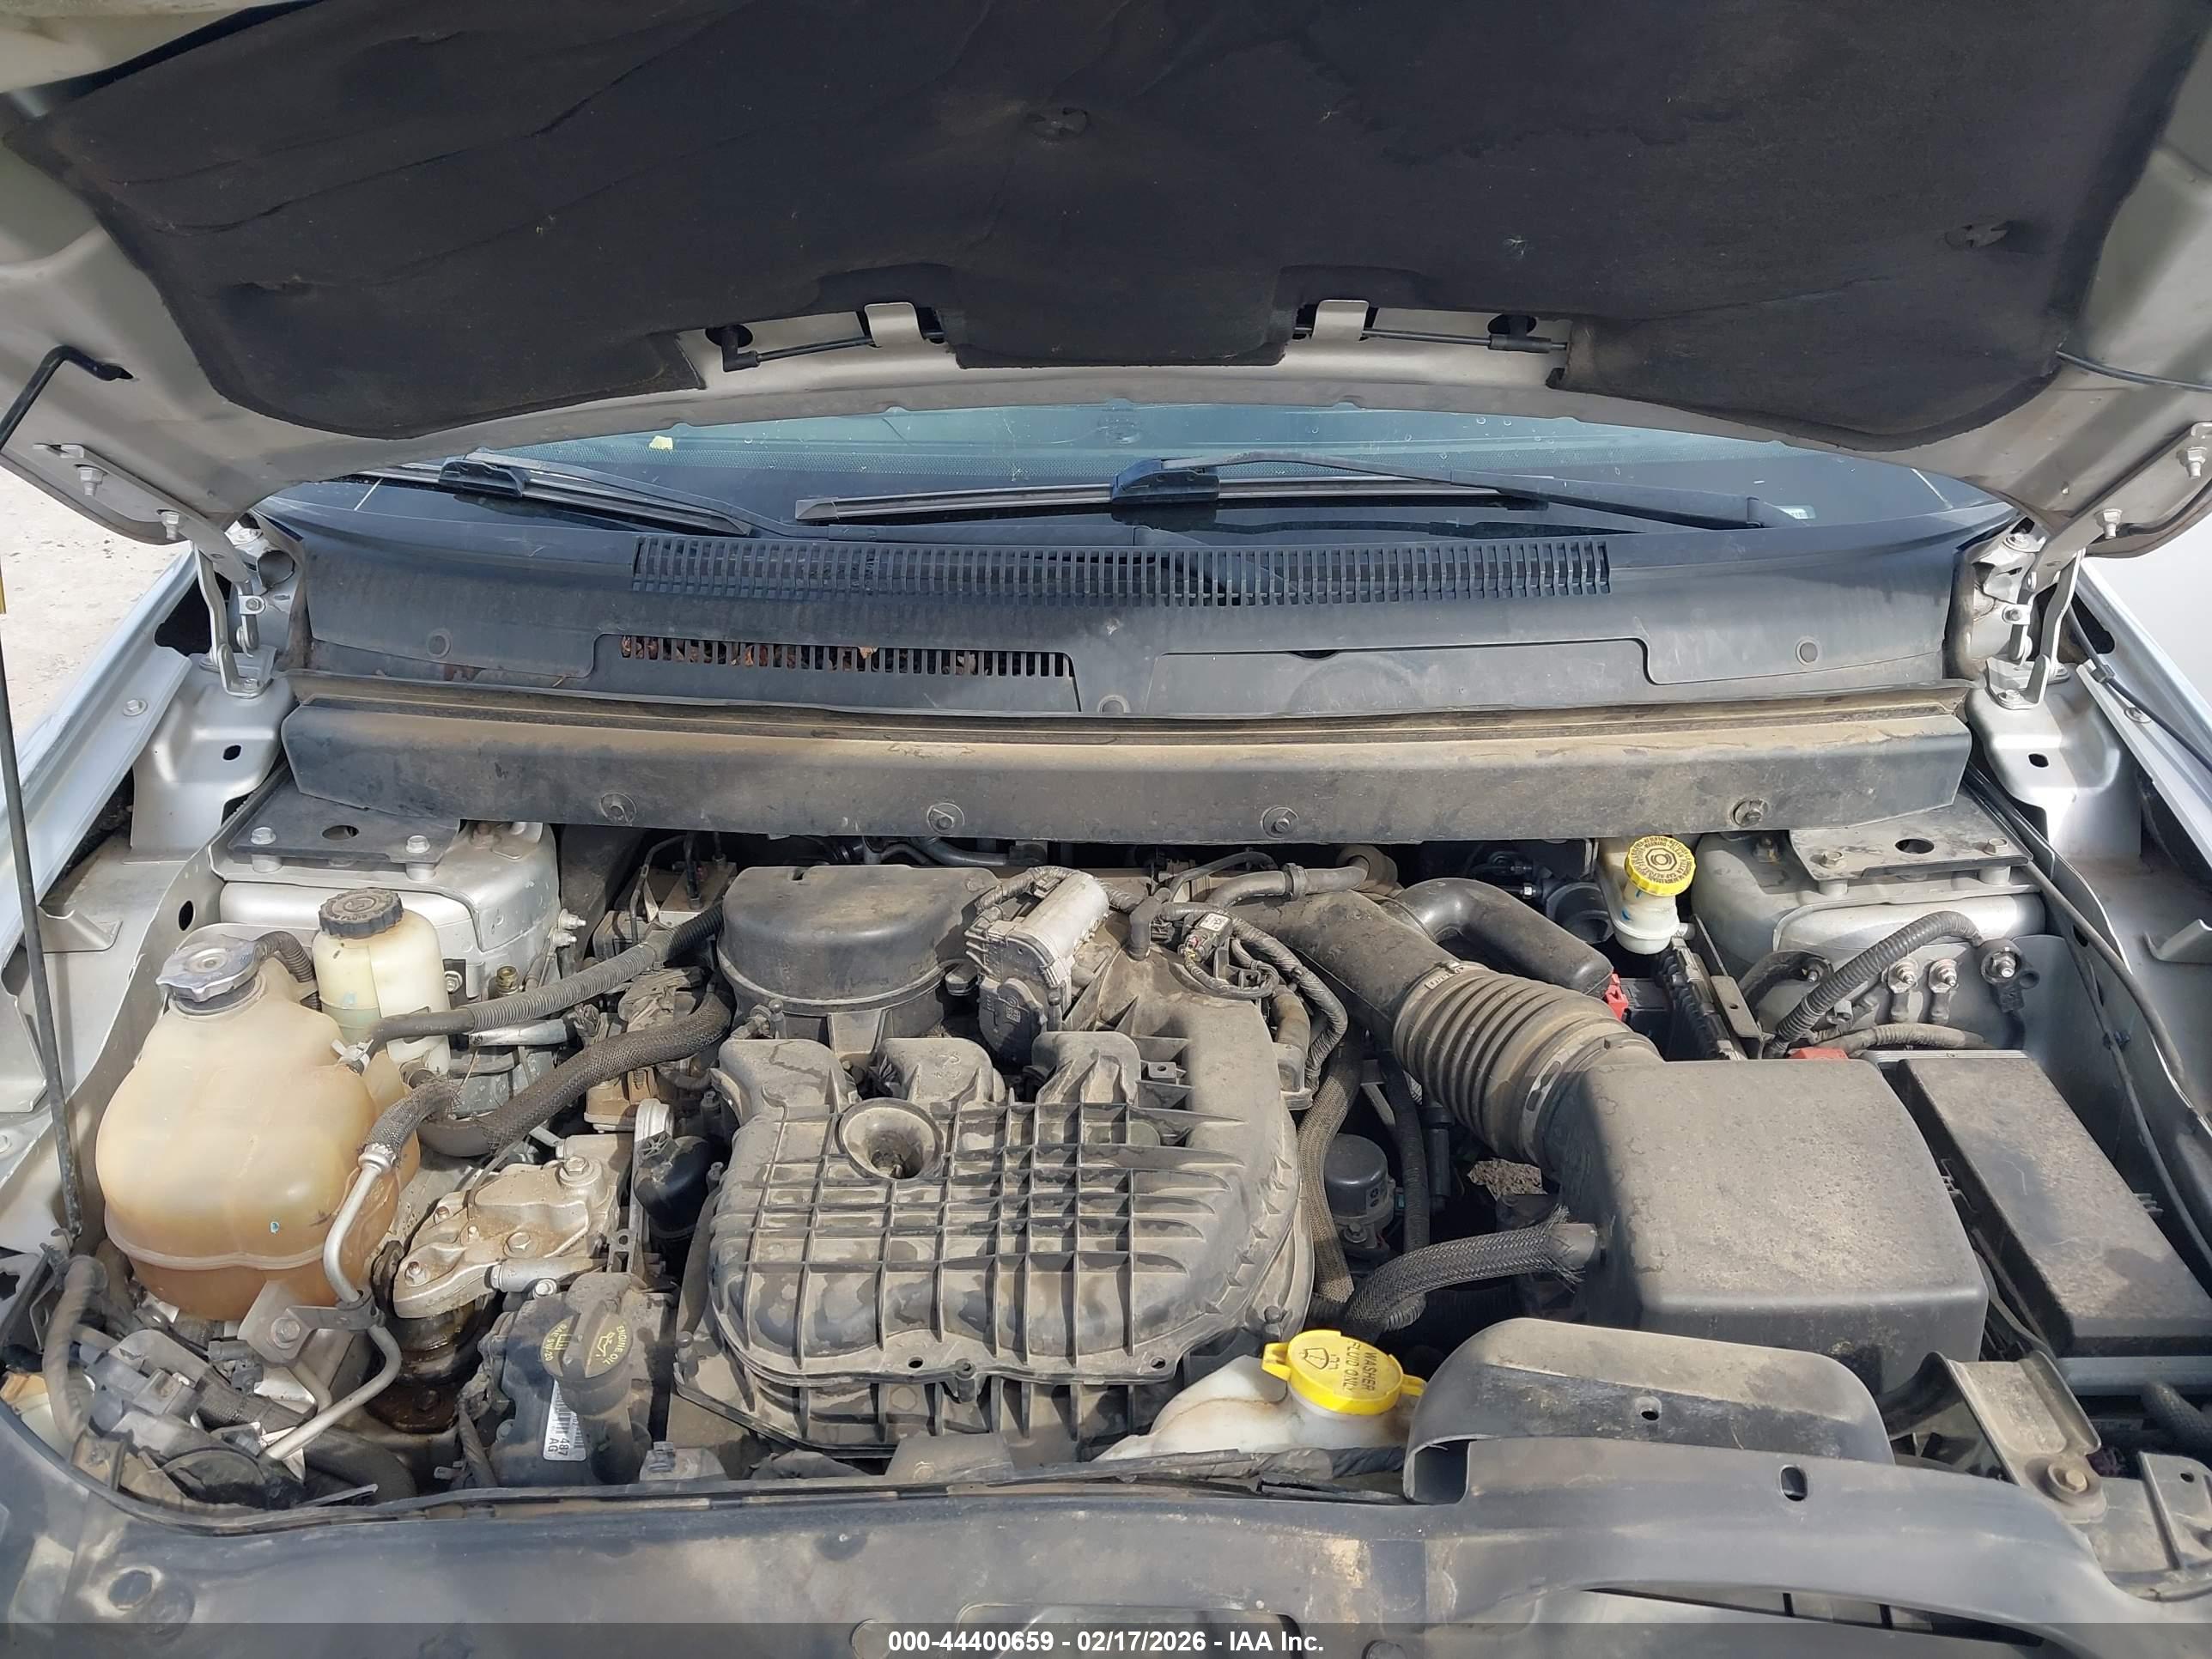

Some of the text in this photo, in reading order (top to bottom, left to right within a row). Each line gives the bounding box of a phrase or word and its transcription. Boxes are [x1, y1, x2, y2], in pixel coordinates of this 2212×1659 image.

[550, 1323, 568, 1338] SAE
[602, 1325, 628, 1367] ENGINE OIL
[1342, 1340, 1361, 1391] FLUID ONLY
[1360, 1352, 1377, 1391] WASHER
[547, 1437, 559, 1453] AG
[558, 1437, 570, 1456] 487
